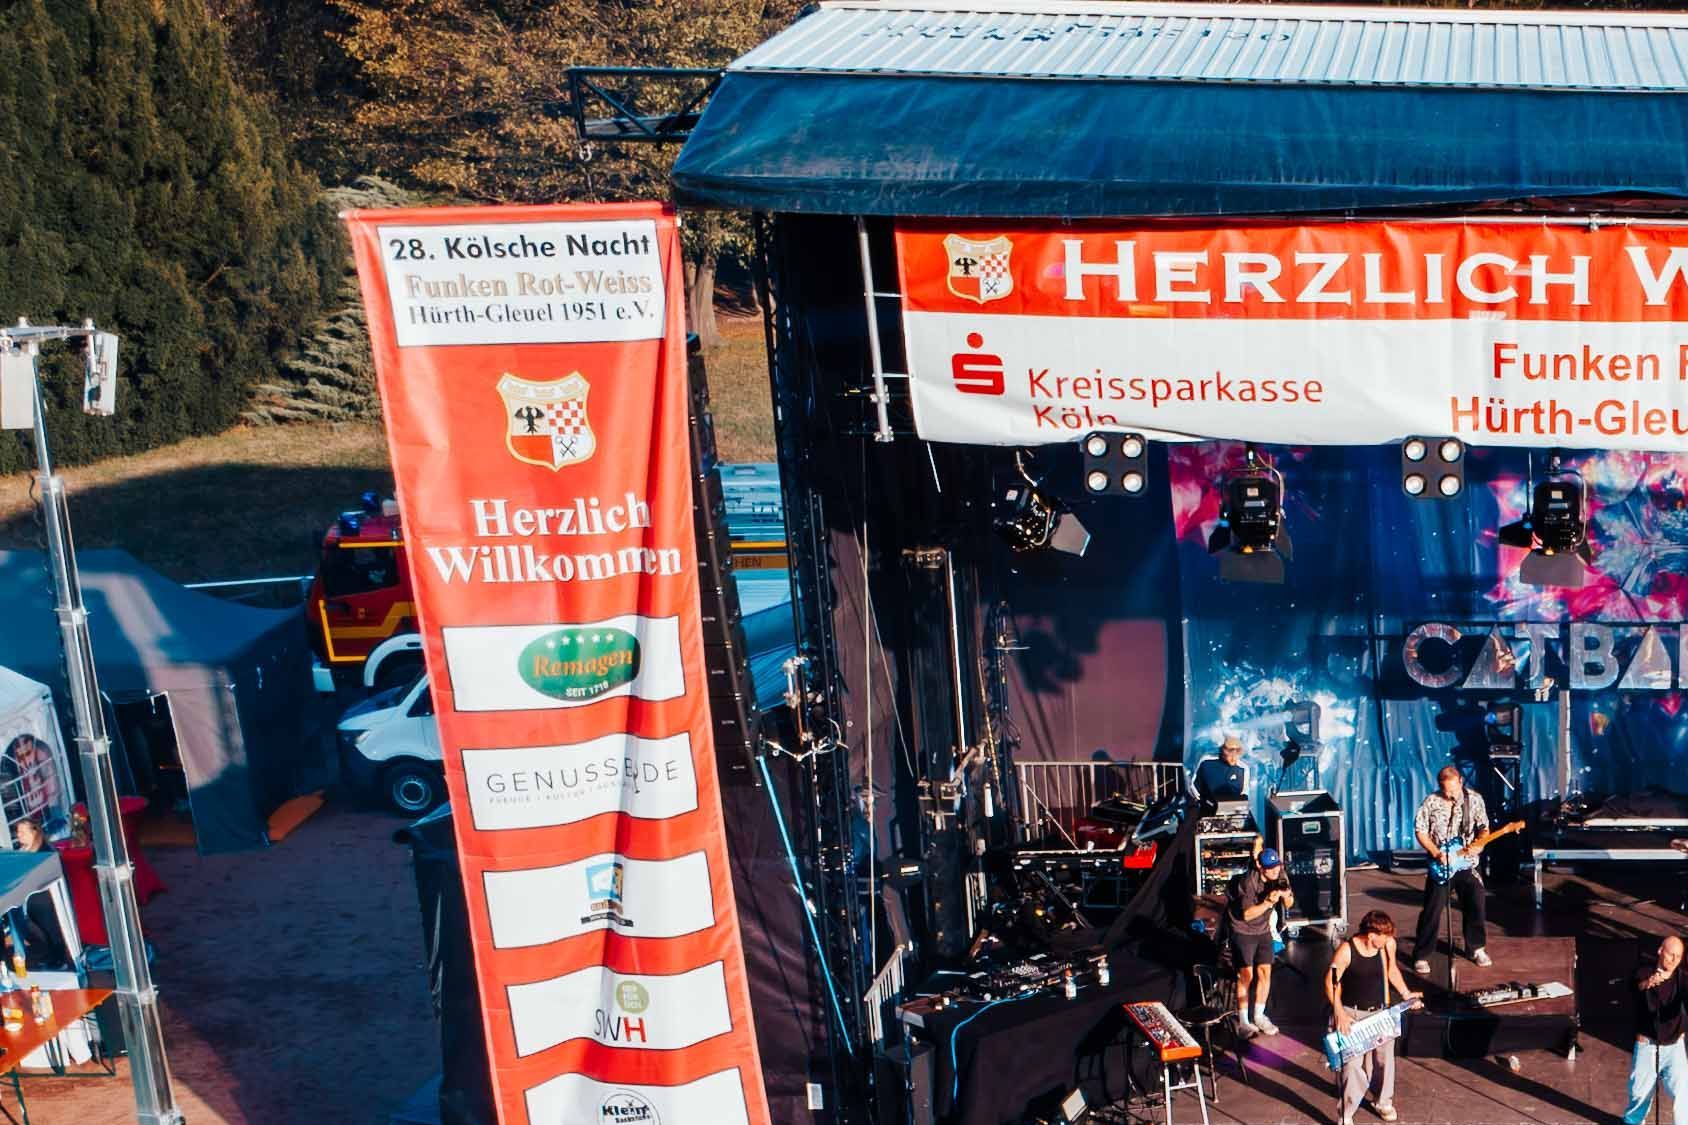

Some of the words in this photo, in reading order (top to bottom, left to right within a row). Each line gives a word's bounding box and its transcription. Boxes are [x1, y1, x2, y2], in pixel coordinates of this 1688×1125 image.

[389, 238, 435, 260] 28.
[444, 234, 556, 261] Kölsche
[566, 231, 651, 257] Nacht
[404, 271, 508, 299] Funken
[518, 269, 653, 297] Rot-Weiss
[409, 301, 553, 325] Hürth-Gleuel
[563, 301, 607, 321] 1951
[616, 299, 654, 321] e.V.
[1493, 342, 1660, 382] Funken
[1028, 368, 1324, 407] Kreissparkasse
[469, 492, 652, 537] Herzlich
[426, 545, 682, 584] Willkommen
[533, 650, 633, 679] Remagen
